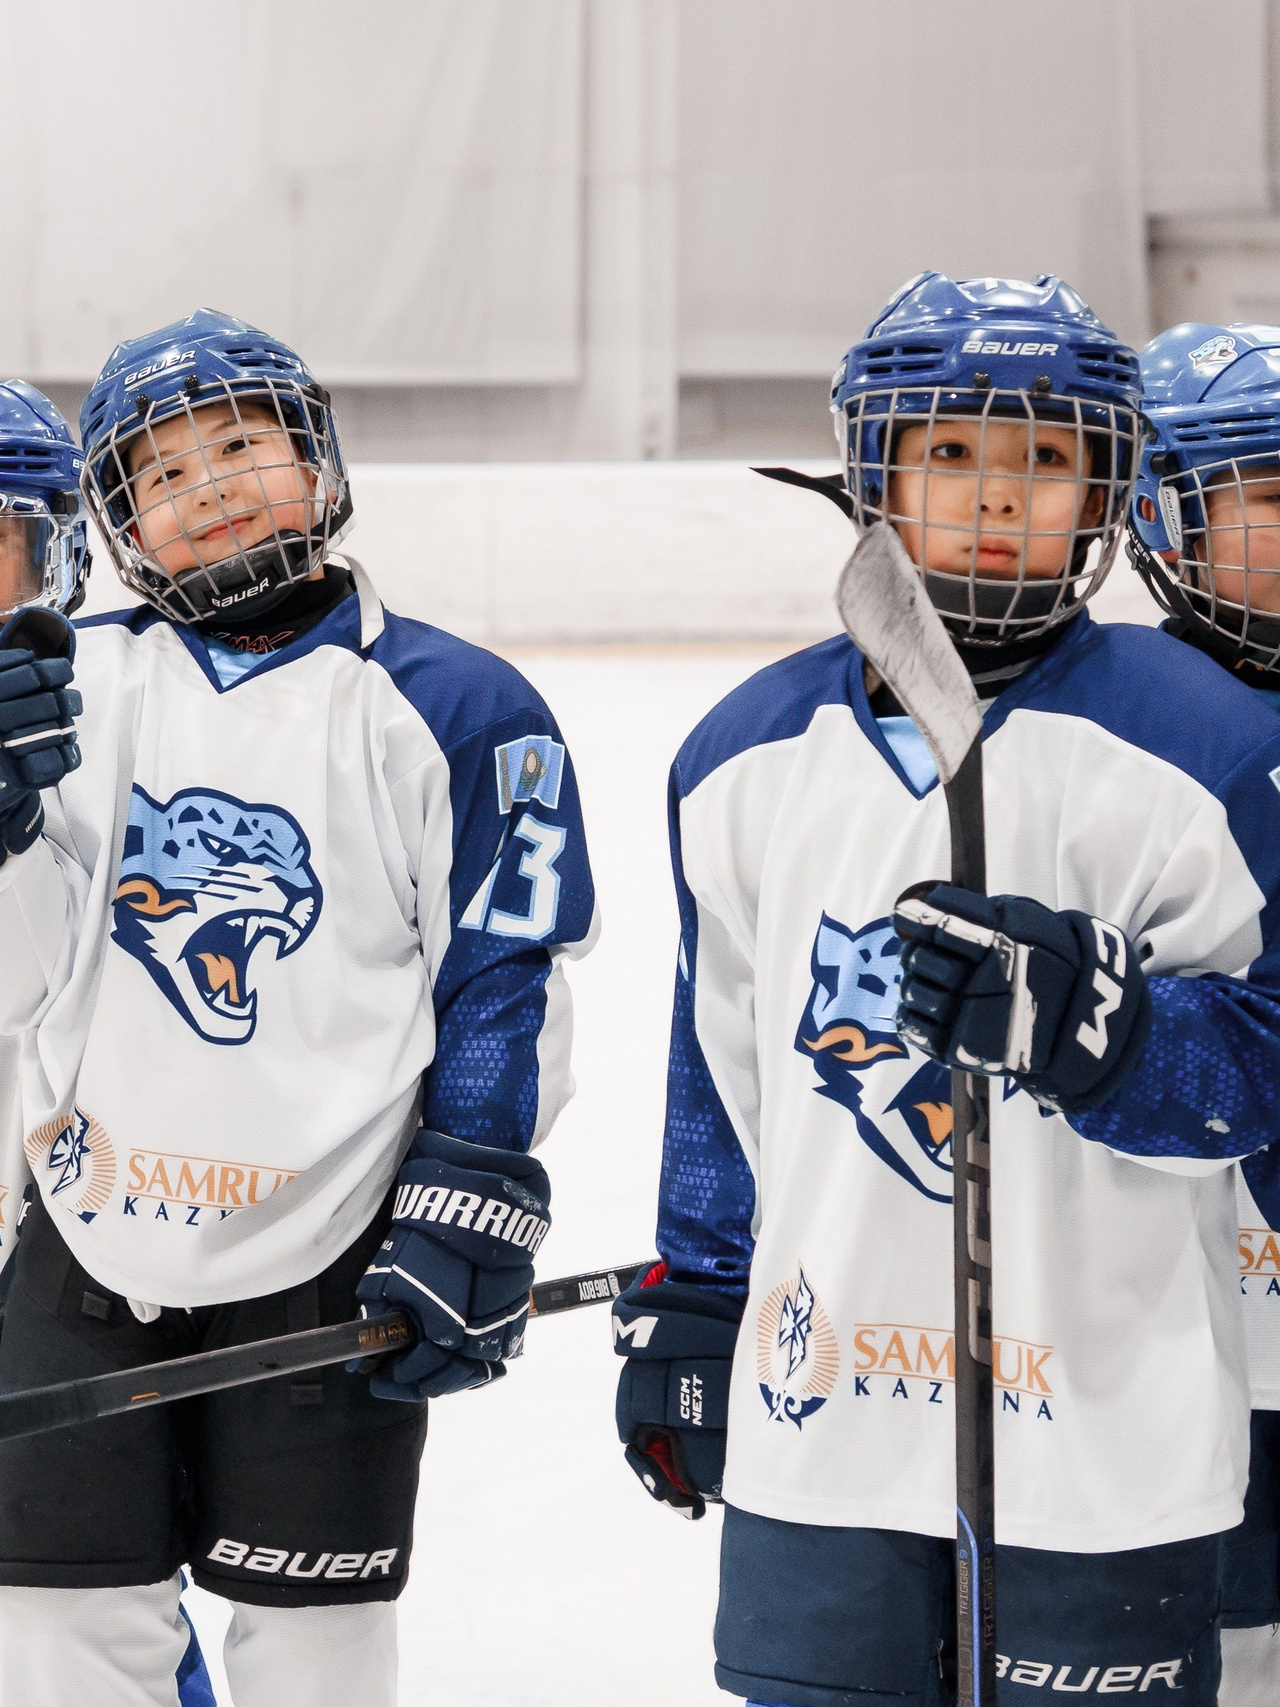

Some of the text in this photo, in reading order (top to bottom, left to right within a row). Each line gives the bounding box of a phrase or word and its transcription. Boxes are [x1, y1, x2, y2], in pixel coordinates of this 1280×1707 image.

[124, 350, 196, 386] BAUER
[961, 340, 1059, 356] BAUER
[212, 577, 270, 608] BAUER
[126, 1154, 294, 1206] SAMRU
[123, 1196, 235, 1226] KAZY
[391, 1184, 549, 1255] WARRIOR
[853, 1329, 1053, 1393] SAMUK
[680, 1377, 691, 1420] CCM
[692, 1374, 703, 1426] NEXT
[854, 1376, 1053, 1421] KAZNA
[207, 1538, 399, 1581] BAUER
[959, 1560, 969, 1616] TRIGGER
